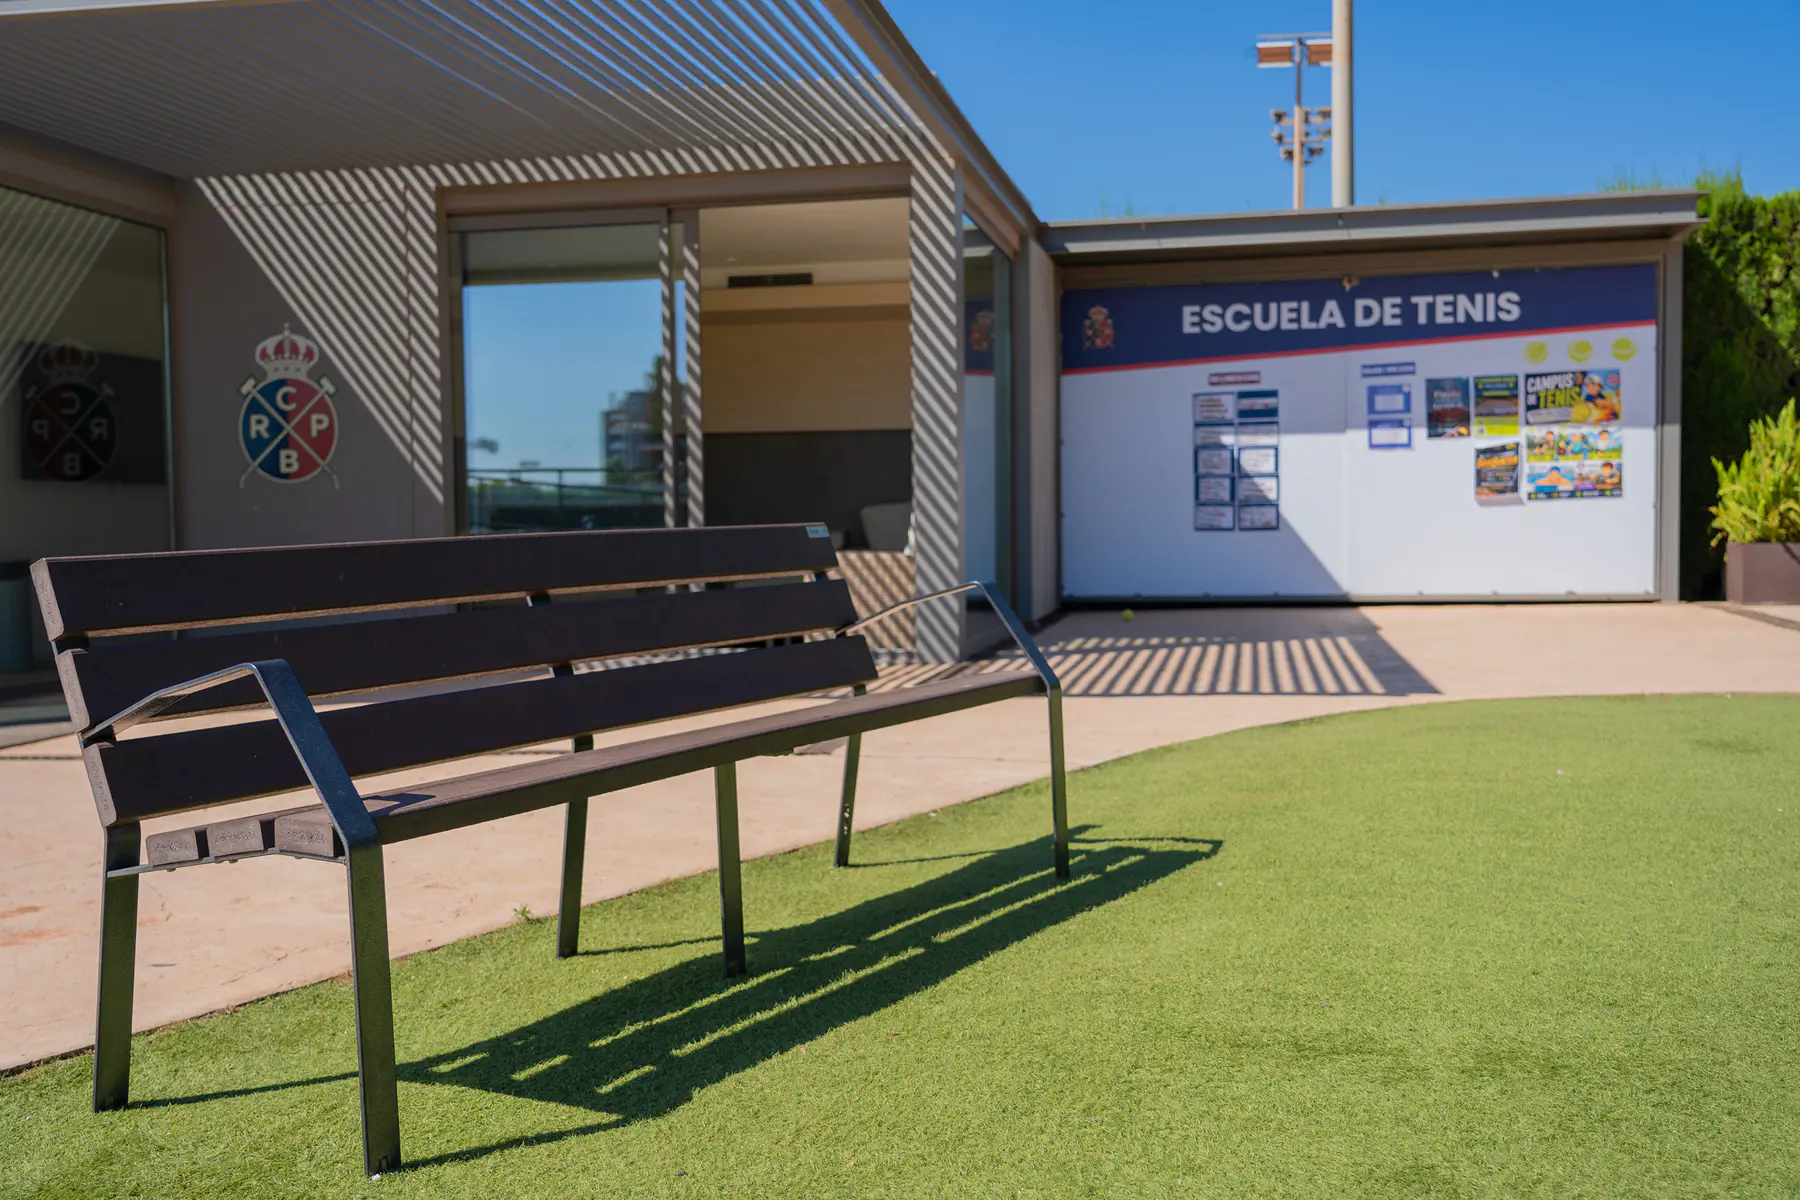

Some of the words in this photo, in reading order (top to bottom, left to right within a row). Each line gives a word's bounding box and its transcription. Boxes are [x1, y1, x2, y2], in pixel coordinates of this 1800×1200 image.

[1182, 299, 1346, 334] ESCUELA
[1354, 297, 1403, 328] DE
[1410, 291, 1521, 325] TENIS
[1526, 373, 1574, 393] CAMPUS
[275, 385, 298, 412] C
[1538, 386, 1582, 409] TENIS
[248, 413, 271, 439] R
[309, 413, 330, 438] P
[279, 449, 300, 474] B
